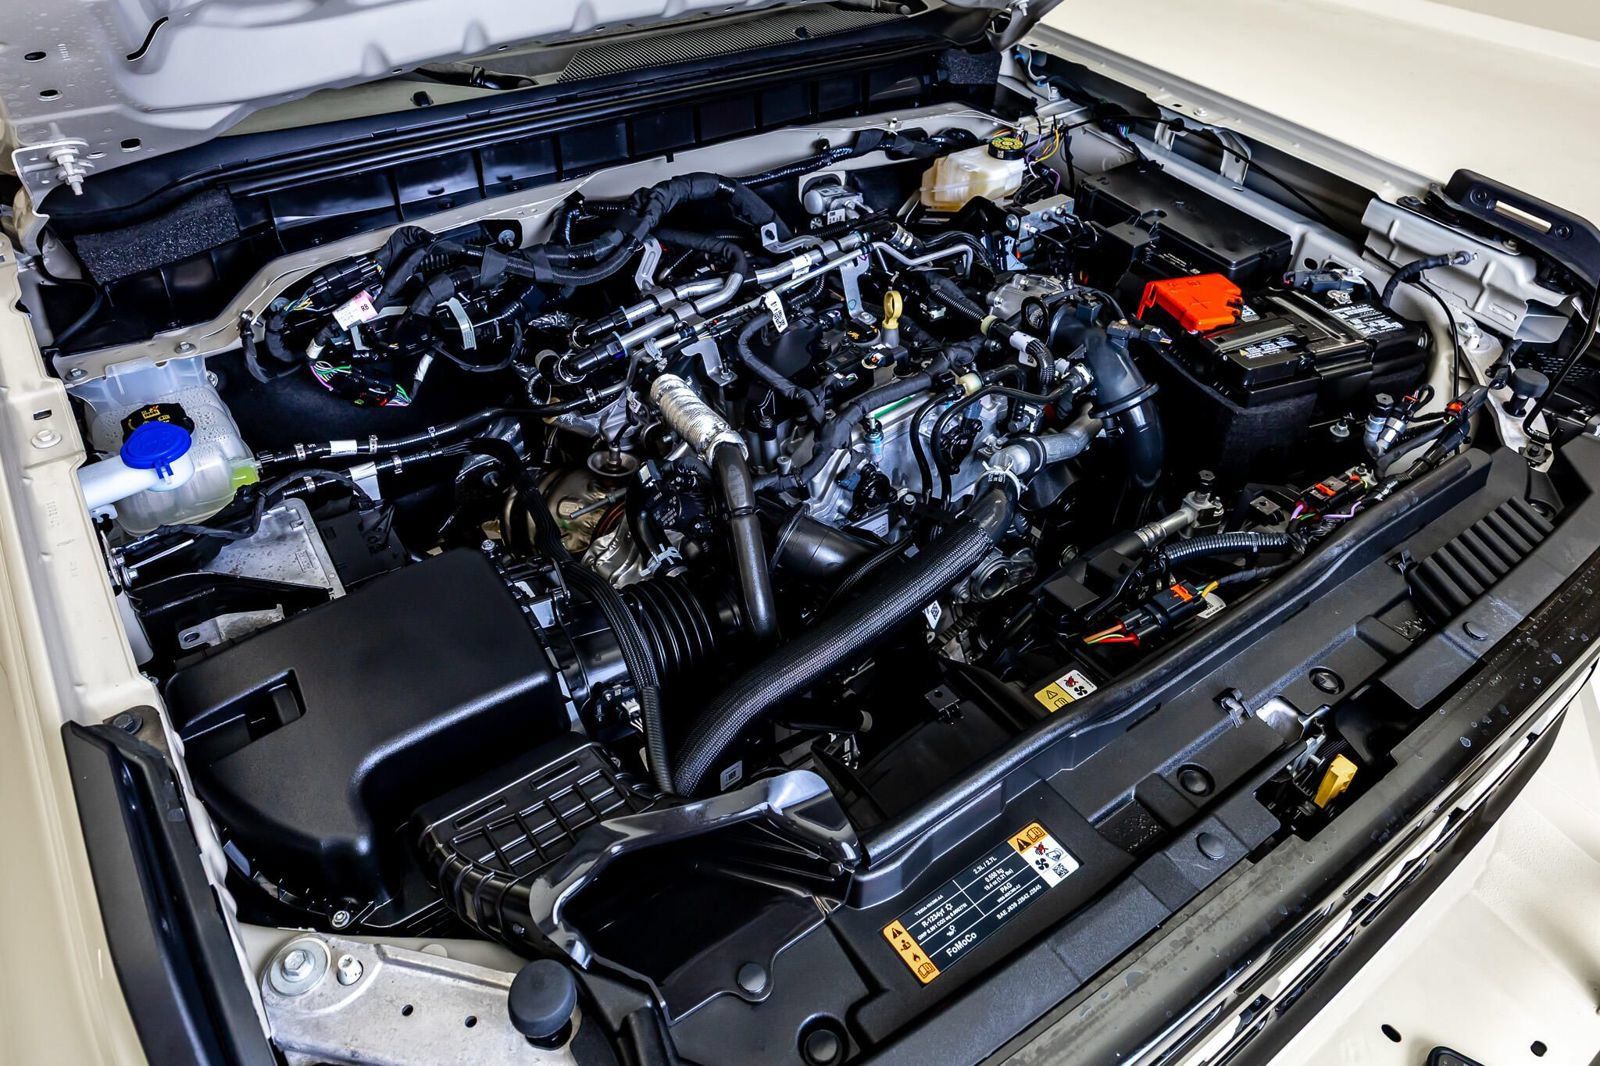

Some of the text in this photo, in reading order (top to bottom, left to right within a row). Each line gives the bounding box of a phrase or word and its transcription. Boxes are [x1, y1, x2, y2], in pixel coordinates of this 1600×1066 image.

[986, 857, 997, 865] 2.7L
[1000, 882, 1012, 893] PAG
[922, 908, 945, 927] R-1234yf
[946, 933, 977, 957] FoMoCo
